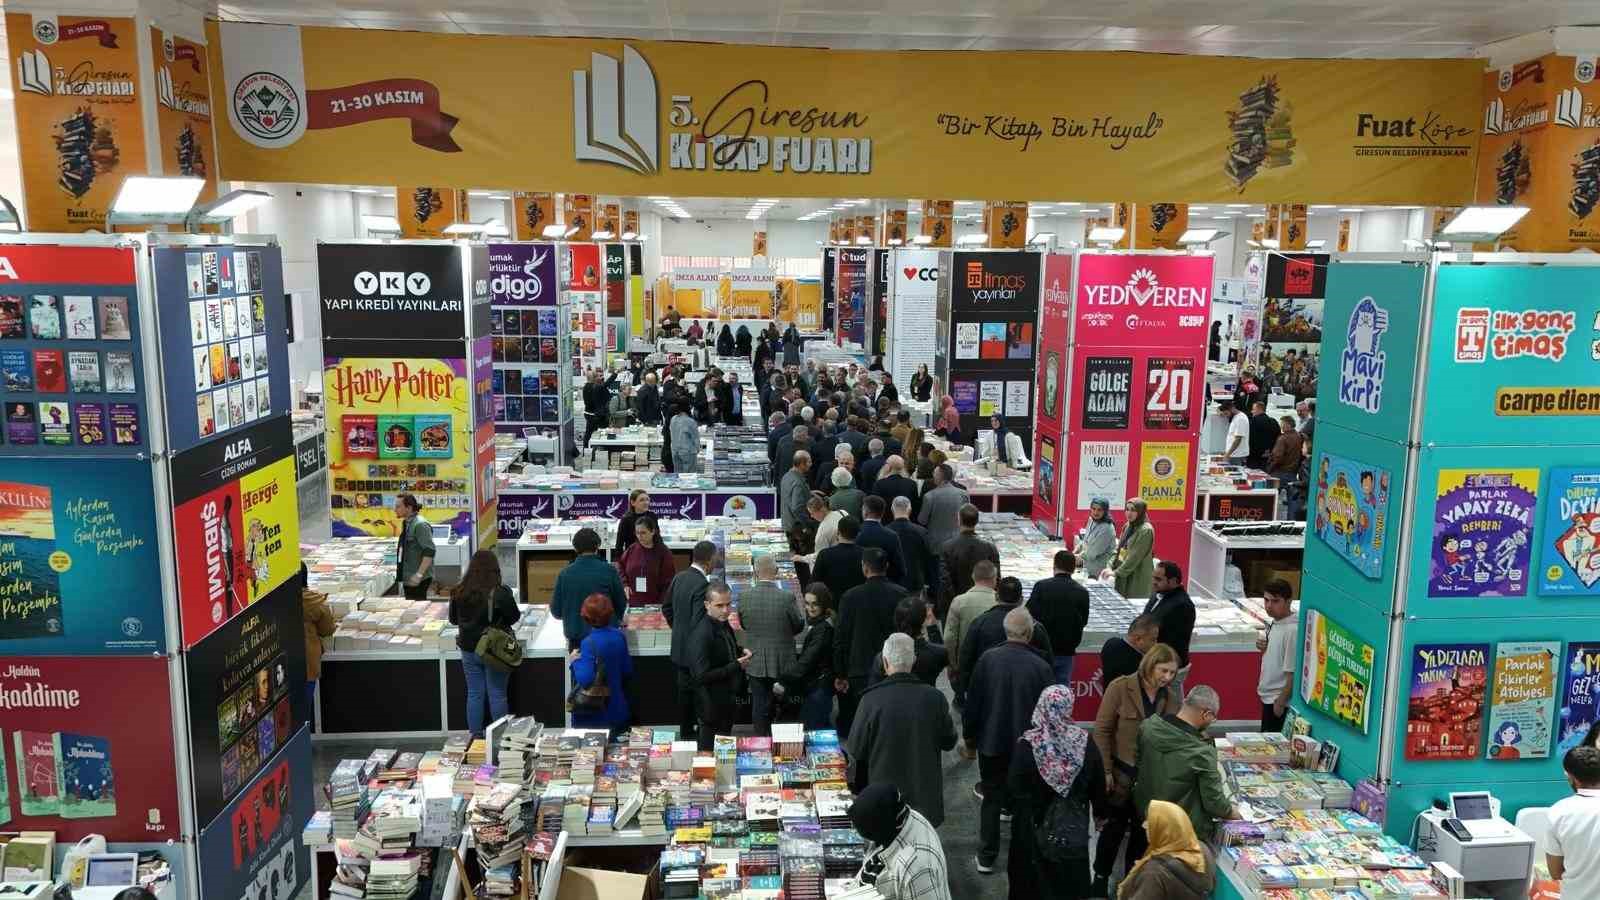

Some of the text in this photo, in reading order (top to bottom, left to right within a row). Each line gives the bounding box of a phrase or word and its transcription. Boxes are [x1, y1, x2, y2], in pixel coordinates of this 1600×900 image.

[331, 90, 424, 113] 21-30 KASIM
[669, 79, 869, 166] 5. Giresun
[1052, 117, 1087, 137] Bin
[1357, 113, 1416, 138] Fuat
[355, 271, 431, 296] YKY
[324, 298, 462, 312] YAPI KREDİ YAYINLARI
[1343, 350, 1384, 380] Mavi
[332, 361, 455, 408] Harry Potter
[1090, 369, 1129, 392] GÖLGE
[1147, 369, 1190, 411] 20
[1087, 393, 1128, 413] ADAM
[1499, 392, 1555, 413] carpe
[224, 437, 252, 463] ALFA
[1441, 500, 1494, 524] YAPAY
[200, 501, 225, 601] ŞİBUMİ
[2, 591, 59, 620] Perşembe
[1419, 649, 1485, 669] YILDIZLARA
